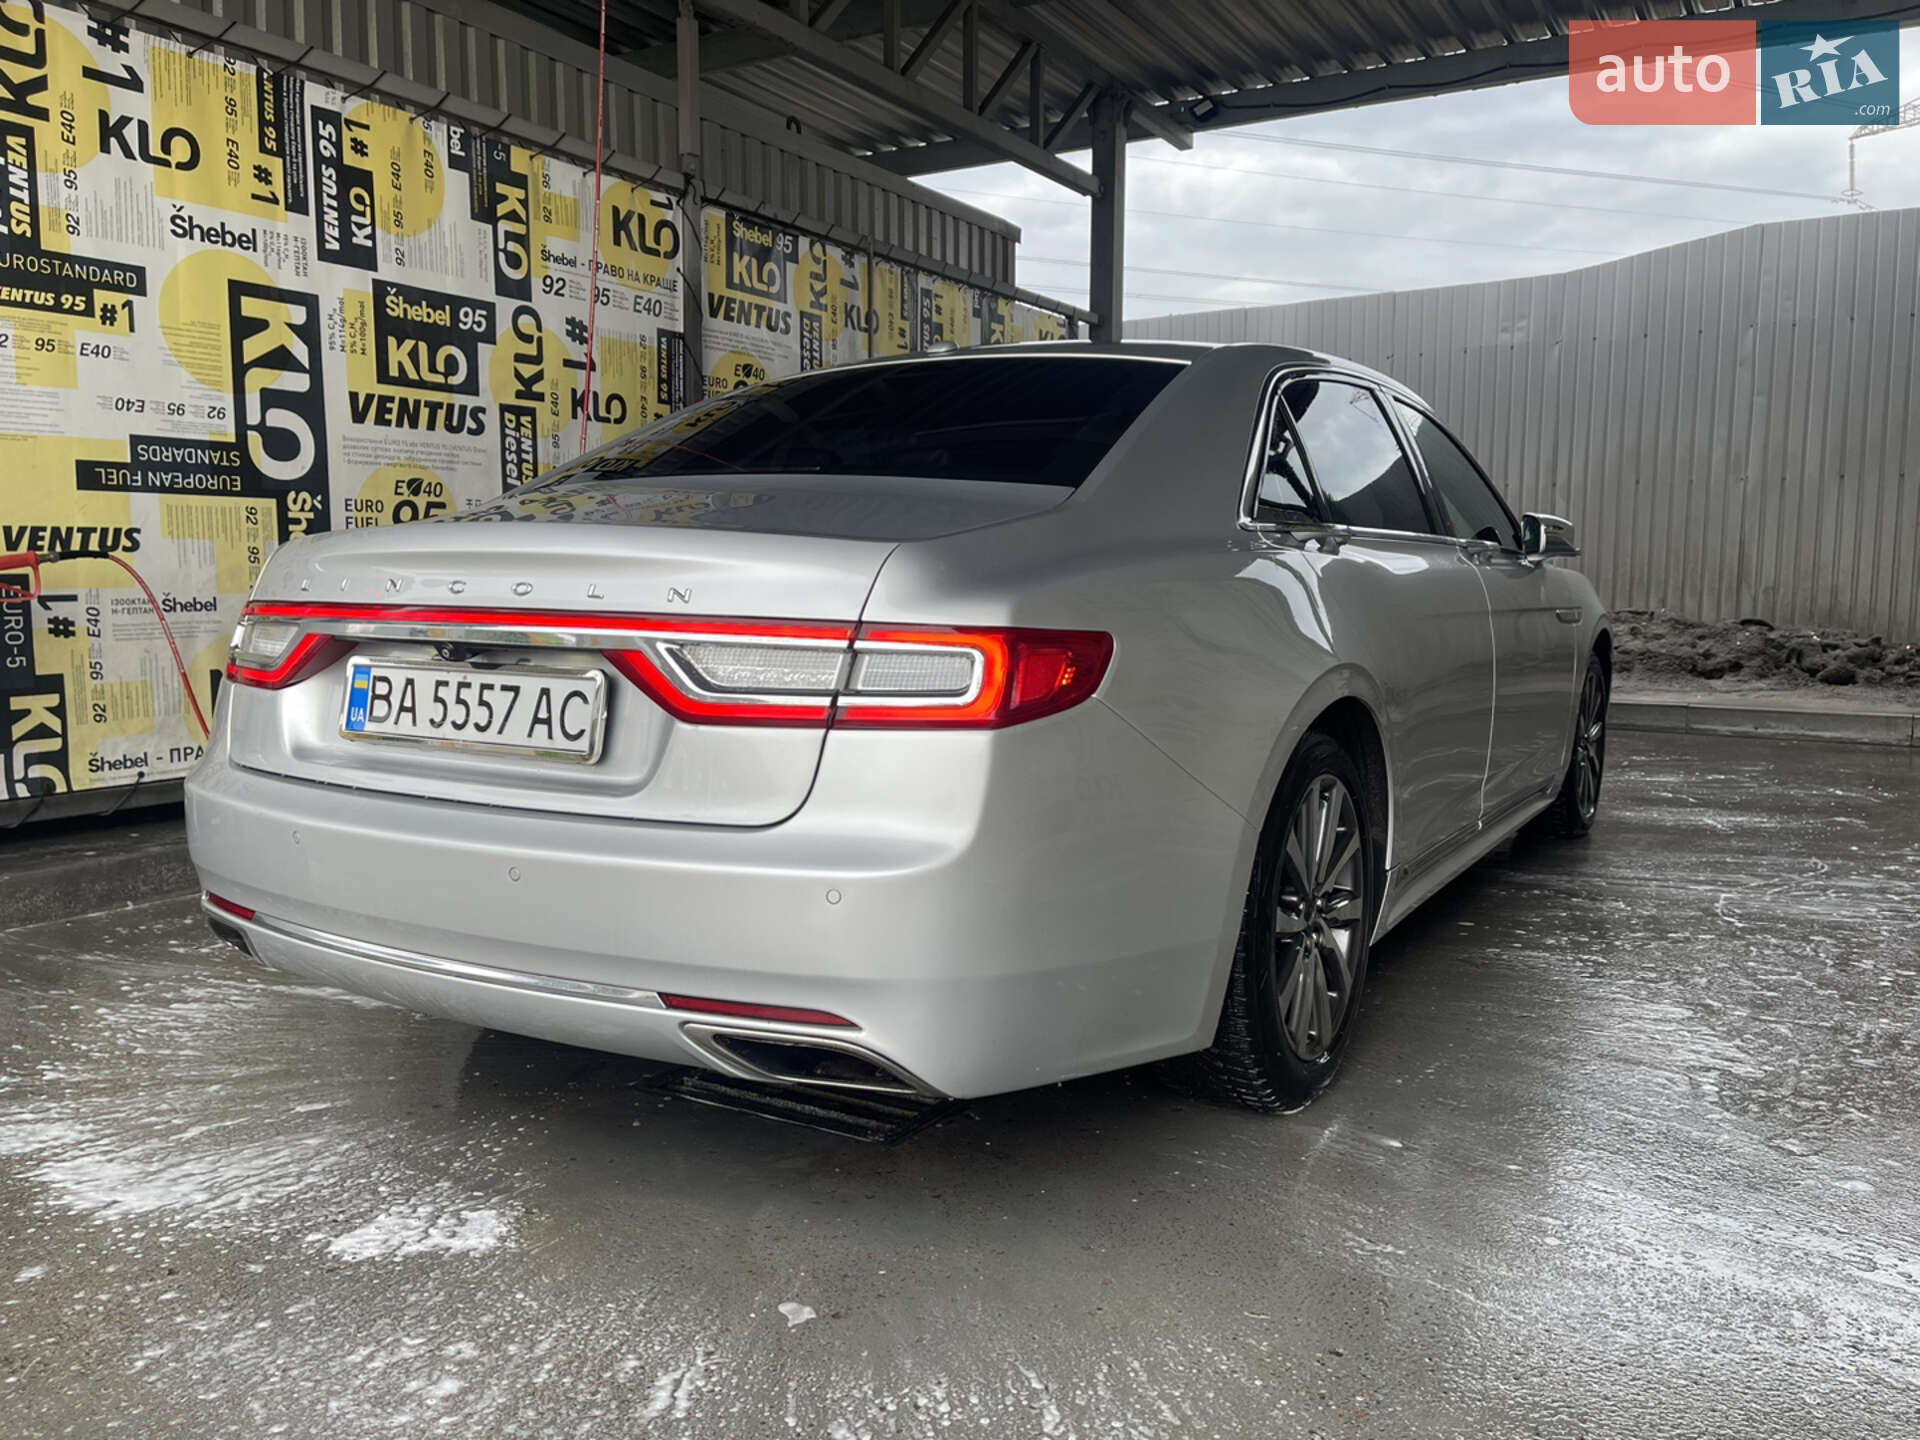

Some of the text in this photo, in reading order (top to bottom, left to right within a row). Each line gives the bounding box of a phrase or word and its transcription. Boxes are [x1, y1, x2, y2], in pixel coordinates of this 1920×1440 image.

[82, 22, 144, 94] #1
[225, 97, 238, 118] 95
[97, 108, 201, 172] KLO
[226, 138, 240, 170] E40
[263, 127, 278, 152] 95
[317, 119, 338, 162] 95
[343, 117, 371, 158] #1
[6, 134, 32, 238] VENTUS
[60, 109, 81, 236] 92 95 E40
[250, 164, 280, 206] #1
[423, 150, 435, 179] E40
[320, 164, 341, 252] VENTUS
[349, 186, 374, 248] KLO
[390, 161, 406, 268] 92 95 E40
[541, 172, 553, 224] 92 95
[169, 203, 258, 252] Šhebel
[495, 181, 529, 281] KLO
[611, 204, 681, 260] KLO
[732, 213, 773, 248] Šhebel
[775, 233, 794, 254] 95
[540, 243, 577, 268] Šhebel
[626, 267, 641, 282] НА
[643, 272, 678, 292] КРАЩЕ
[732, 251, 781, 294] KLO
[60, 293, 87, 312] 95
[99, 299, 136, 333] #1
[385, 286, 488, 332] Šhebel 95
[542, 274, 662, 318] 92 95 E40
[707, 291, 793, 335] VENTUS
[34, 337, 56, 353] 95
[80, 342, 111, 359] E40
[386, 335, 468, 385] KLO
[511, 304, 546, 402] KLO
[114, 396, 226, 420] 92 95 E40
[240, 295, 317, 481] KLO
[347, 390, 487, 436] VENTUS
[550, 391, 561, 449] 95 E40
[138, 444, 241, 466] STANDARDS
[504, 411, 521, 486] Diesel
[94, 467, 241, 491] EUROPEAN FUEL
[344, 498, 384, 514] EURO
[2, 525, 142, 553] VENTUS
[245, 506, 260, 565] 92 95
[161, 592, 217, 613] Šhebel
[300, 577, 694, 604] LINCOLN
[37, 594, 79, 638] #1
[86, 606, 108, 724] 92 95 E40
[350, 706, 365, 723] UA
[367, 674, 590, 742] BA 5557 AC
[88, 751, 149, 774] Šhebel
